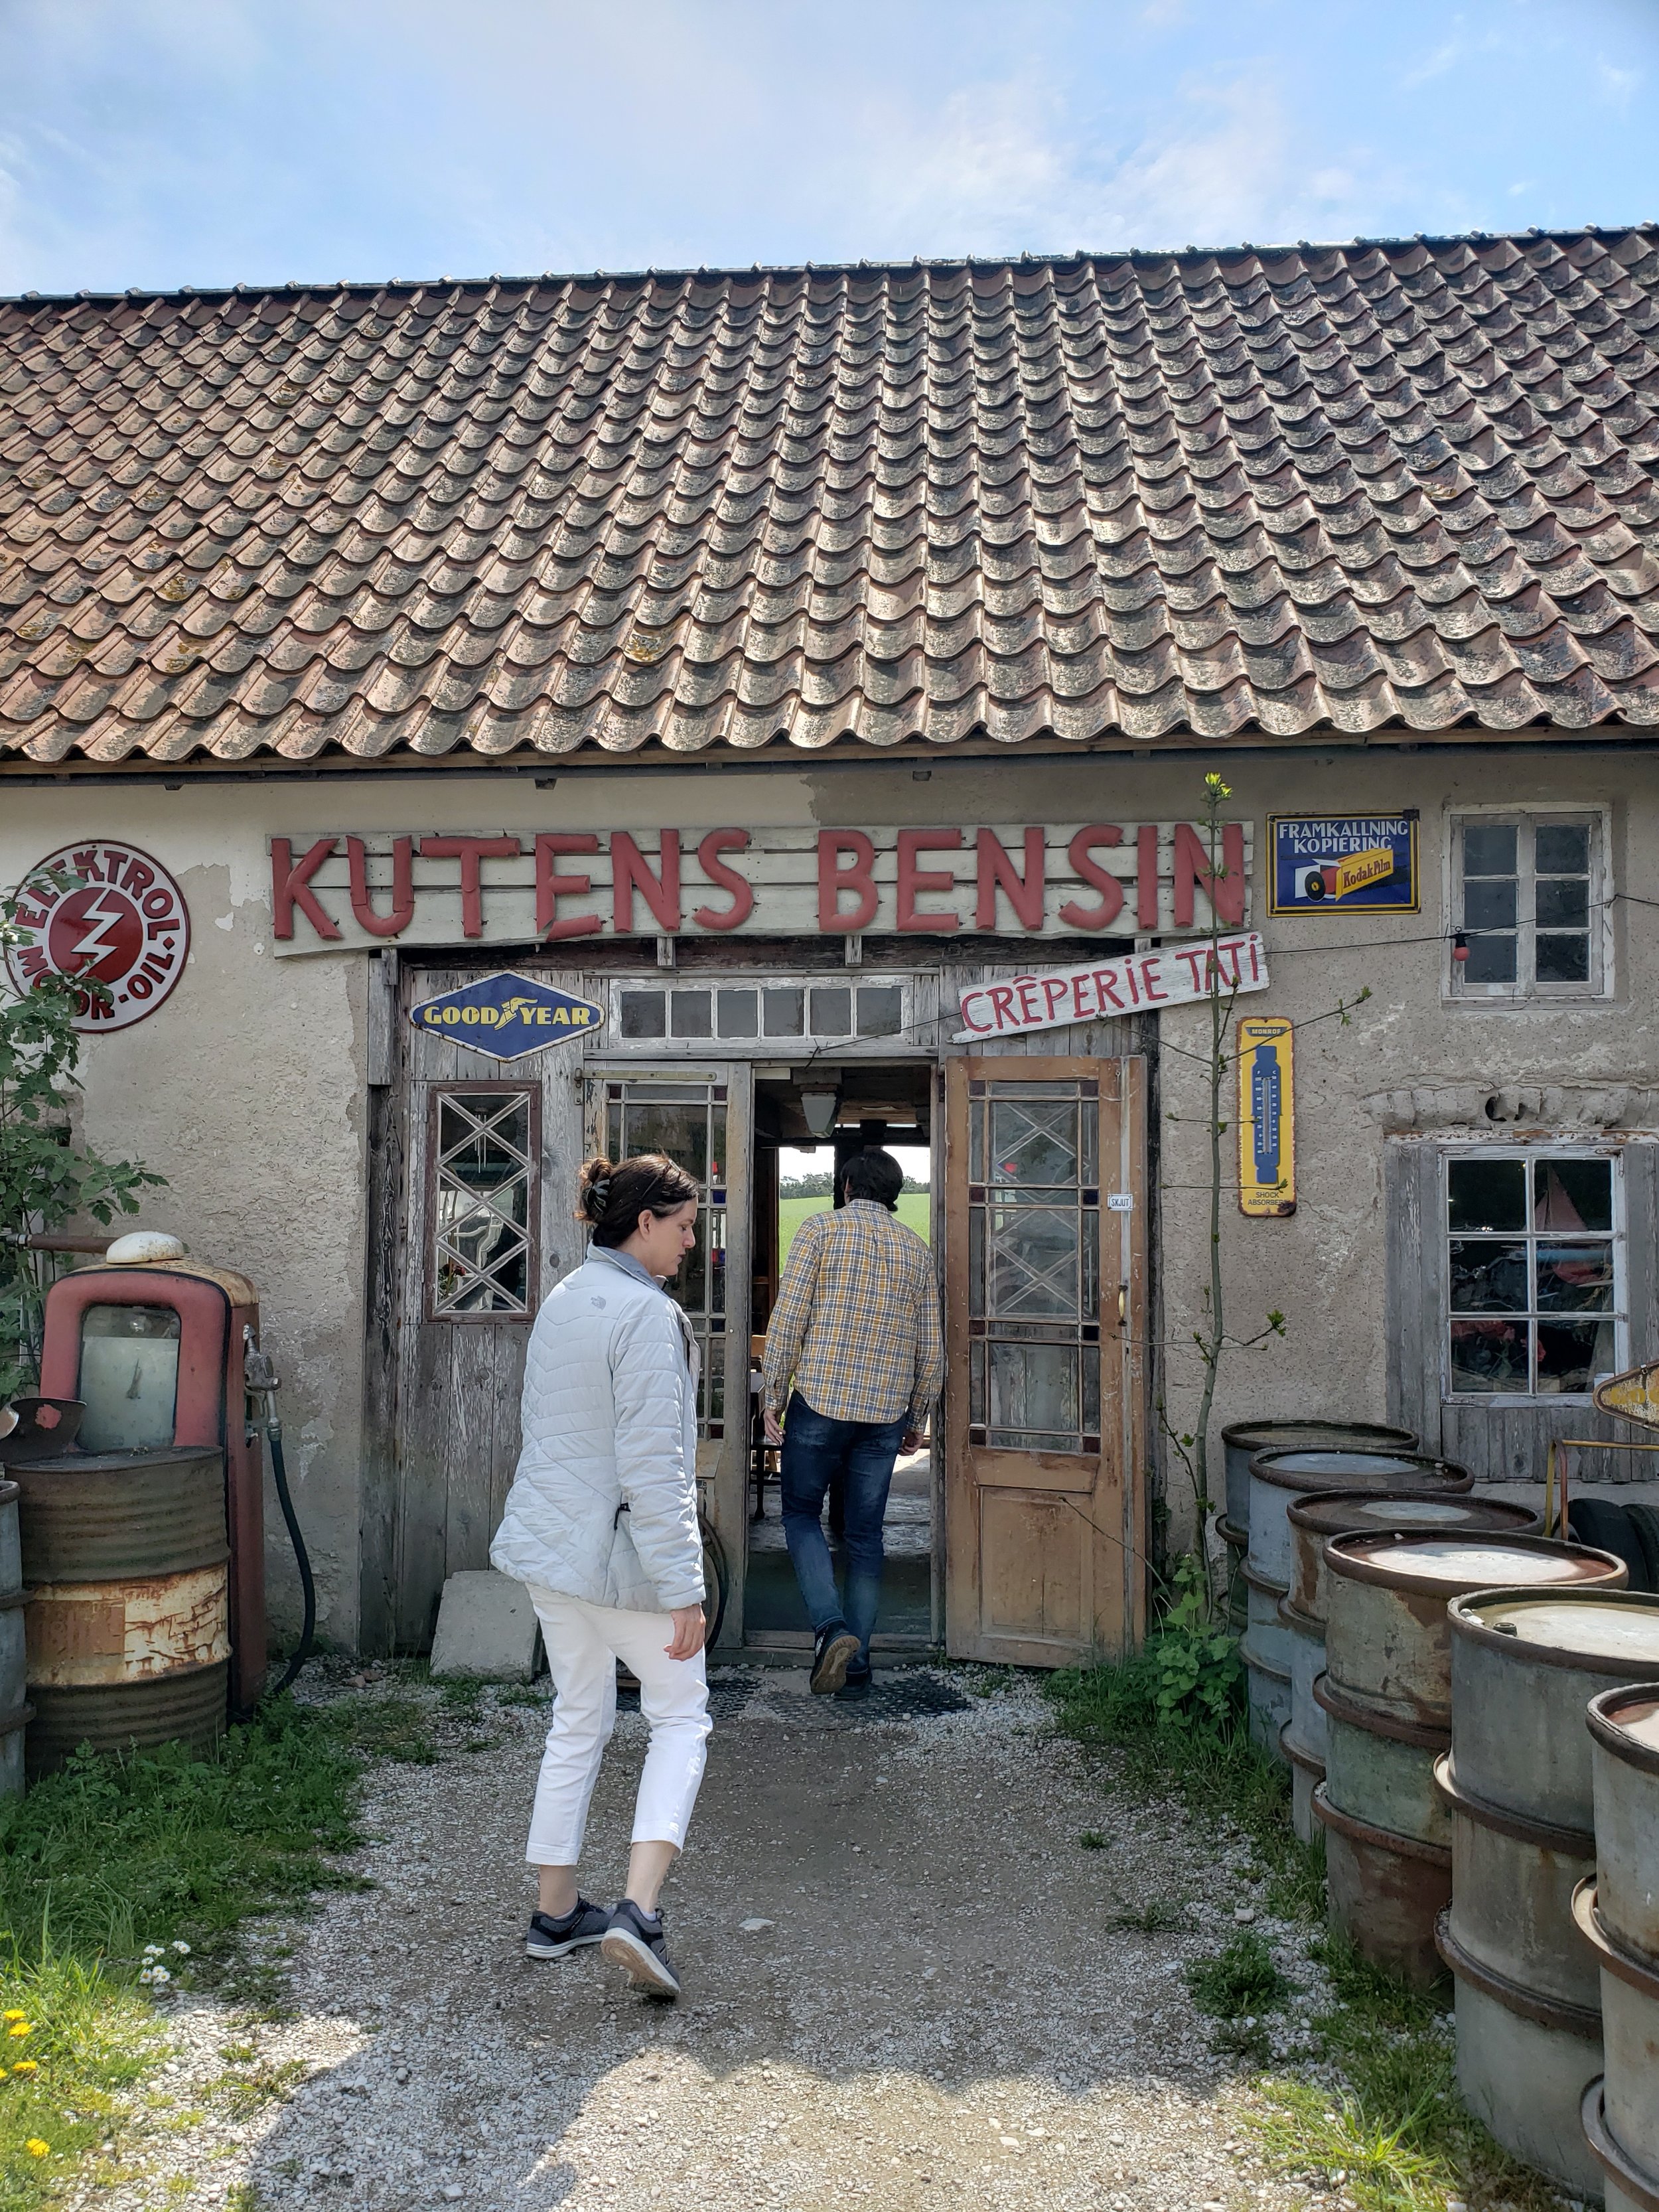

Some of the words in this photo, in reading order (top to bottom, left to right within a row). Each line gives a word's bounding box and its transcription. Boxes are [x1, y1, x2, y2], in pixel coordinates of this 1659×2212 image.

[1279, 820, 1408, 839] FRAMKALLNING
[1294, 836, 1392, 853] KOPIERING
[271, 827, 755, 942] KUTENS
[818, 823, 1246, 930] BENSIN
[1343, 863, 1374, 889] Kodak
[127, 952, 175, 999] OIL
[1111, 1198, 1129, 1207] SKJUT
